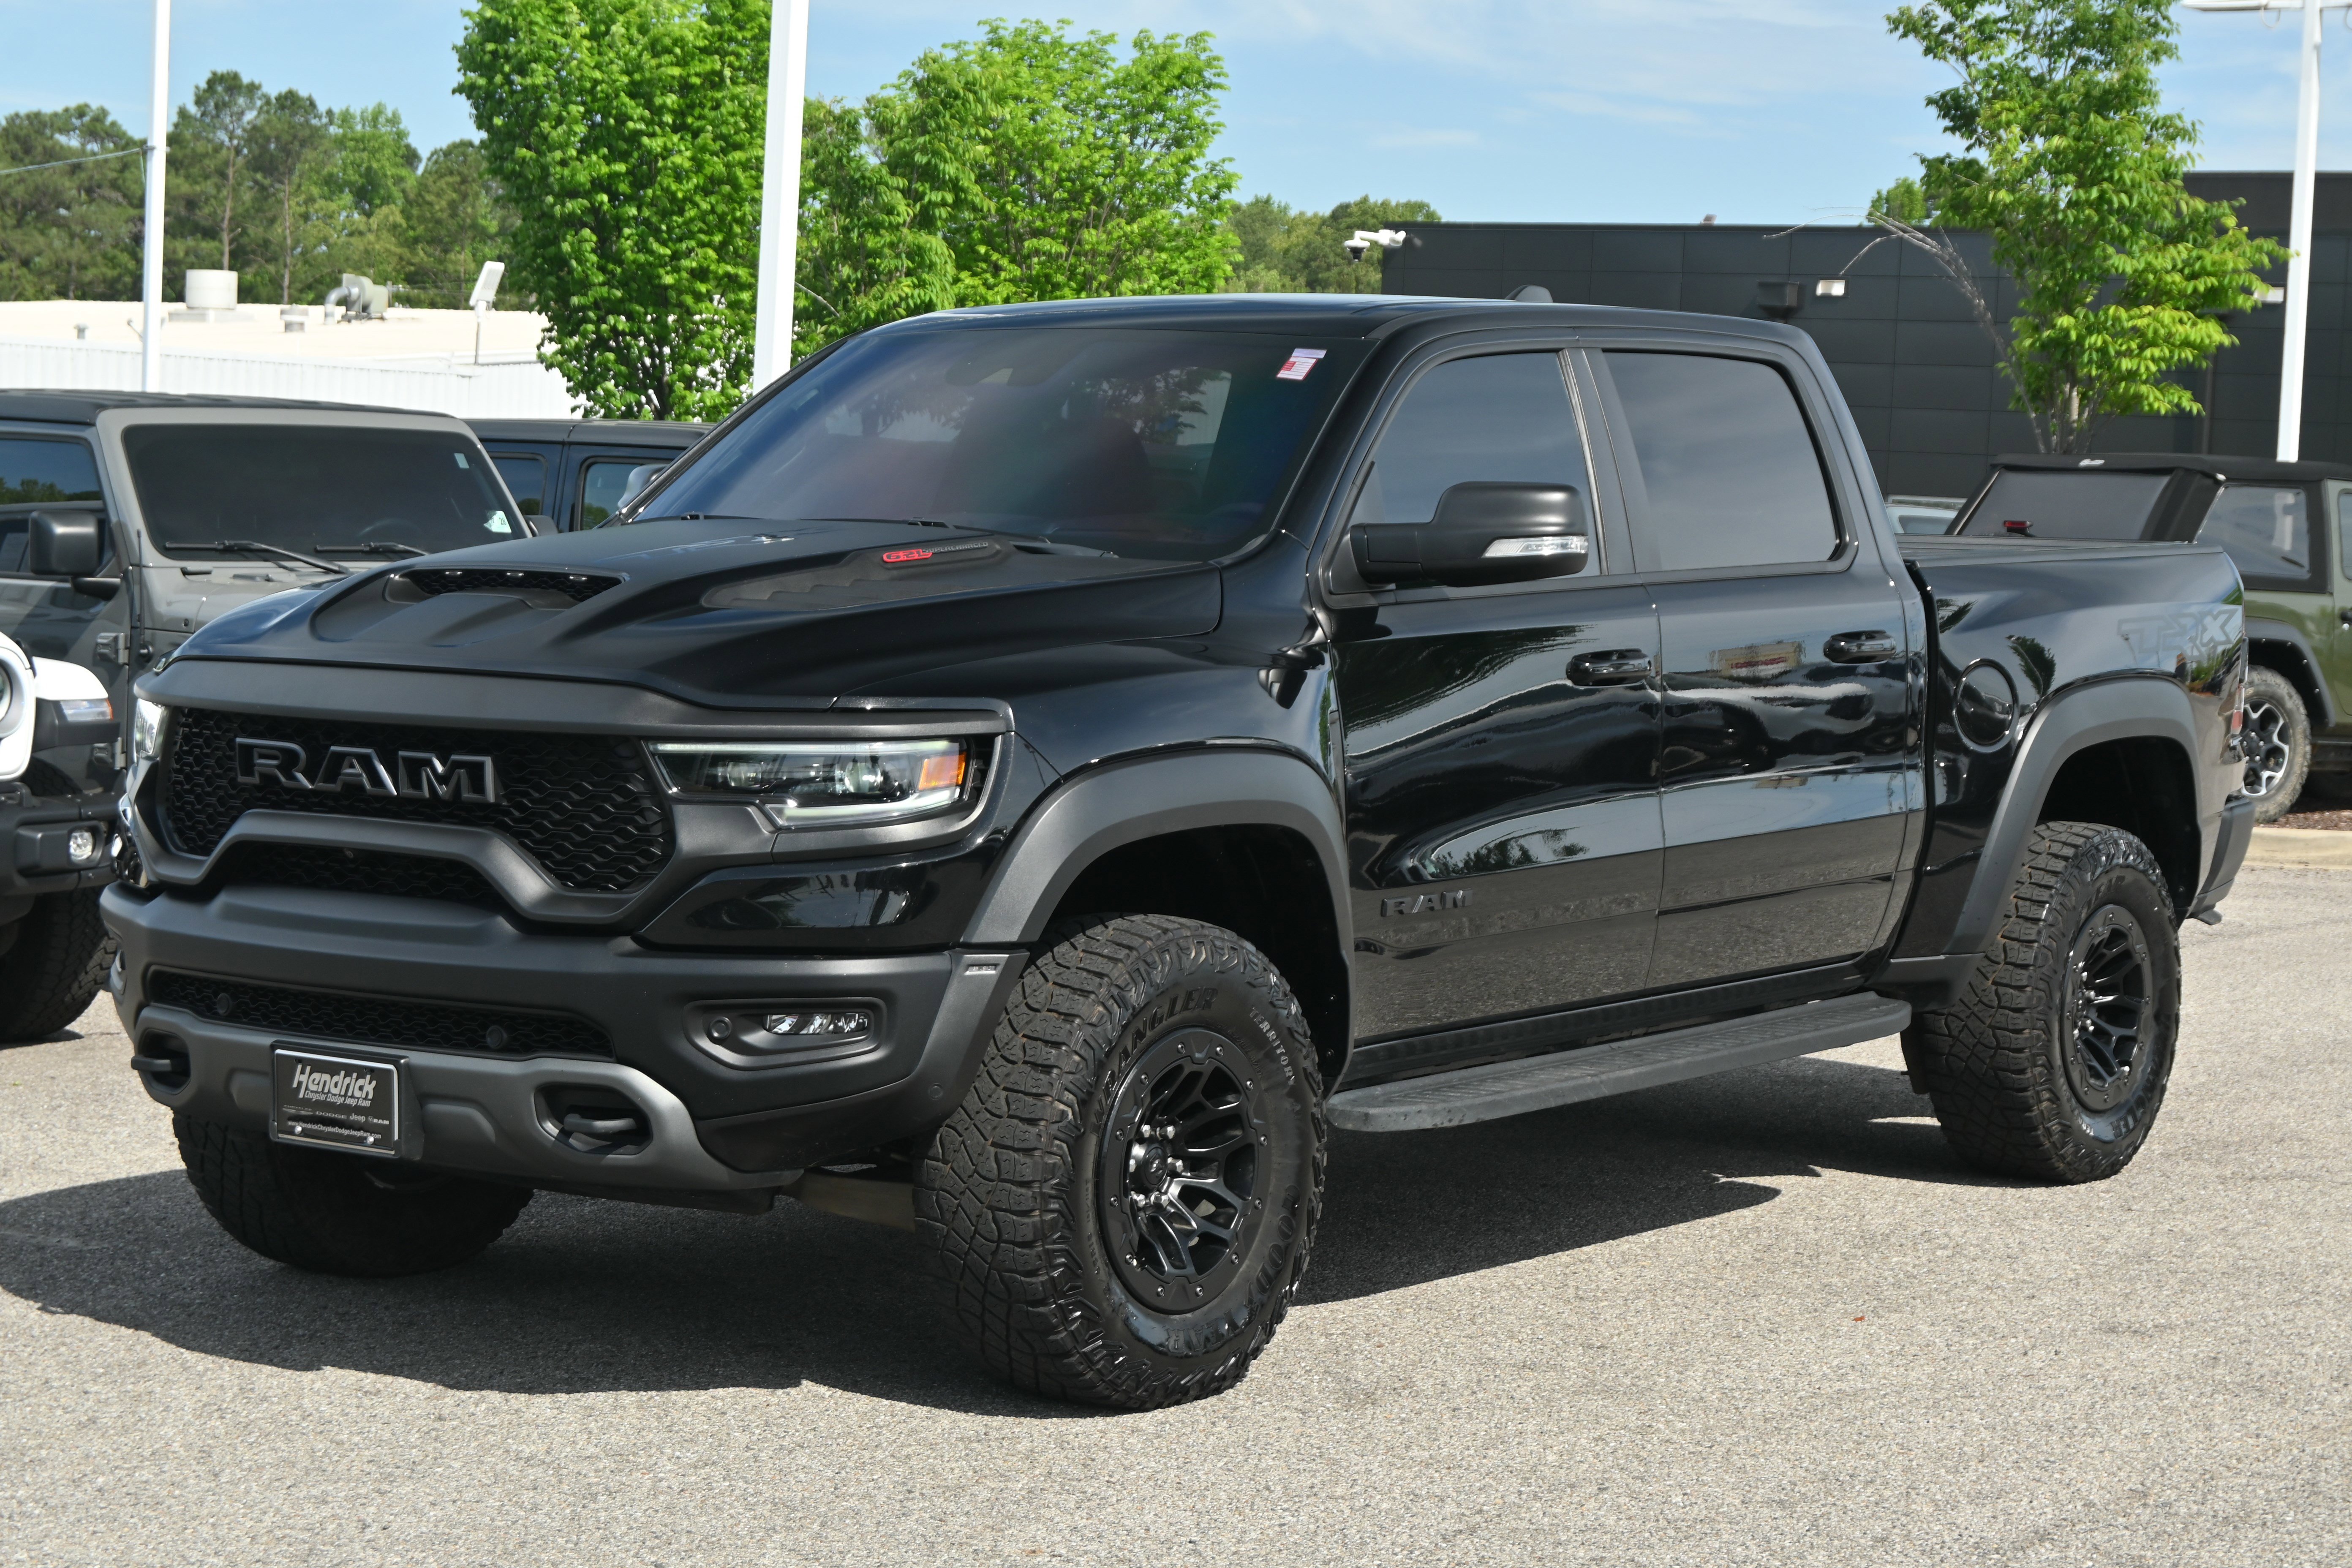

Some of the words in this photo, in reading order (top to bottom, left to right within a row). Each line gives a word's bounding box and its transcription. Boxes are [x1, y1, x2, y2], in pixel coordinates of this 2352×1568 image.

[883, 549, 932, 563] 6.2L
[922, 542, 989, 553] SUPERCHARGED
[2117, 607, 2239, 662] TRX
[236, 737, 495, 802] RAM
[1380, 888, 1473, 917] RAM
[1090, 987, 1218, 1137] WRANGLER
[1249, 1007, 1296, 1085] TERRITORY
[293, 1064, 377, 1100] Hendrick
[305, 1090, 327, 1101] Chrysler
[327, 1093, 344, 1104] Dodge
[344, 1096, 358, 1107] Jeep
[358, 1098, 371, 1107] Ram
[288, 1121, 381, 1139] www.HendrickChryslerDodgeJeepRam.com
[350, 1113, 366, 1122] Jeep
